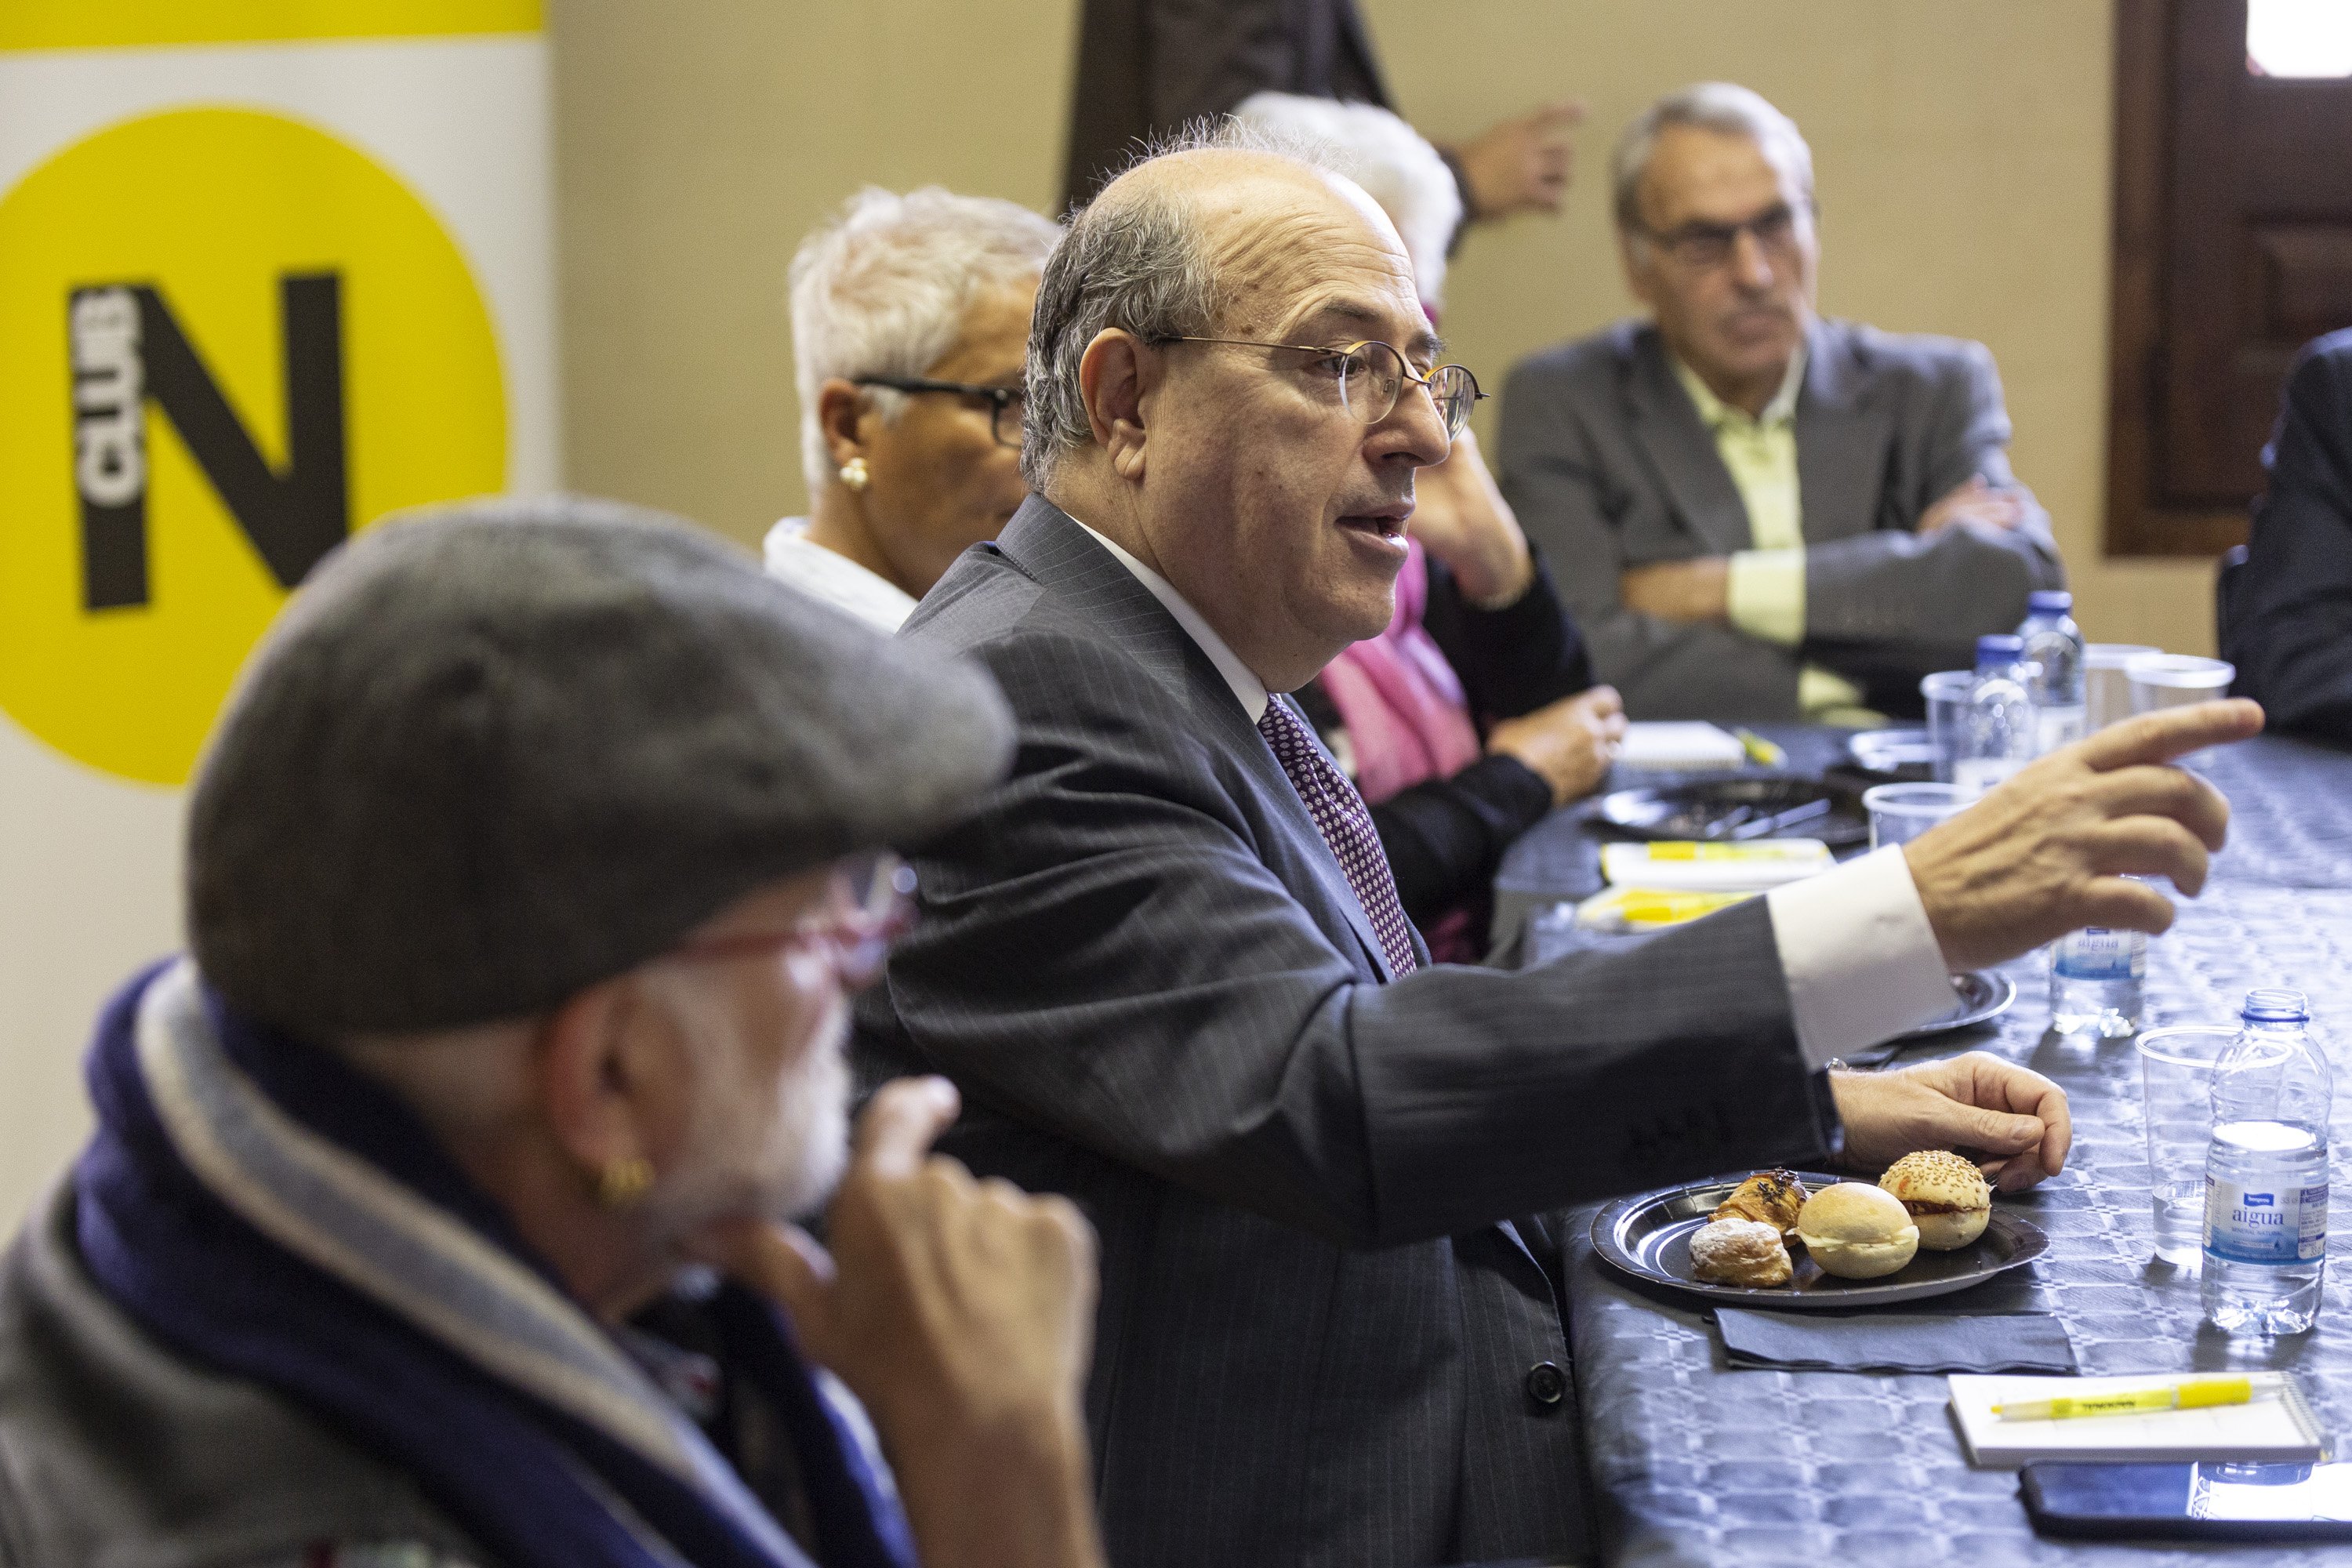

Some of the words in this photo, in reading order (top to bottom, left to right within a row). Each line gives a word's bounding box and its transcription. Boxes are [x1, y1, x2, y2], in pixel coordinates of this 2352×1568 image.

[69, 269, 351, 609] N
[73, 288, 145, 508] CLUB
[2232, 1207, 2285, 1228] aigua
